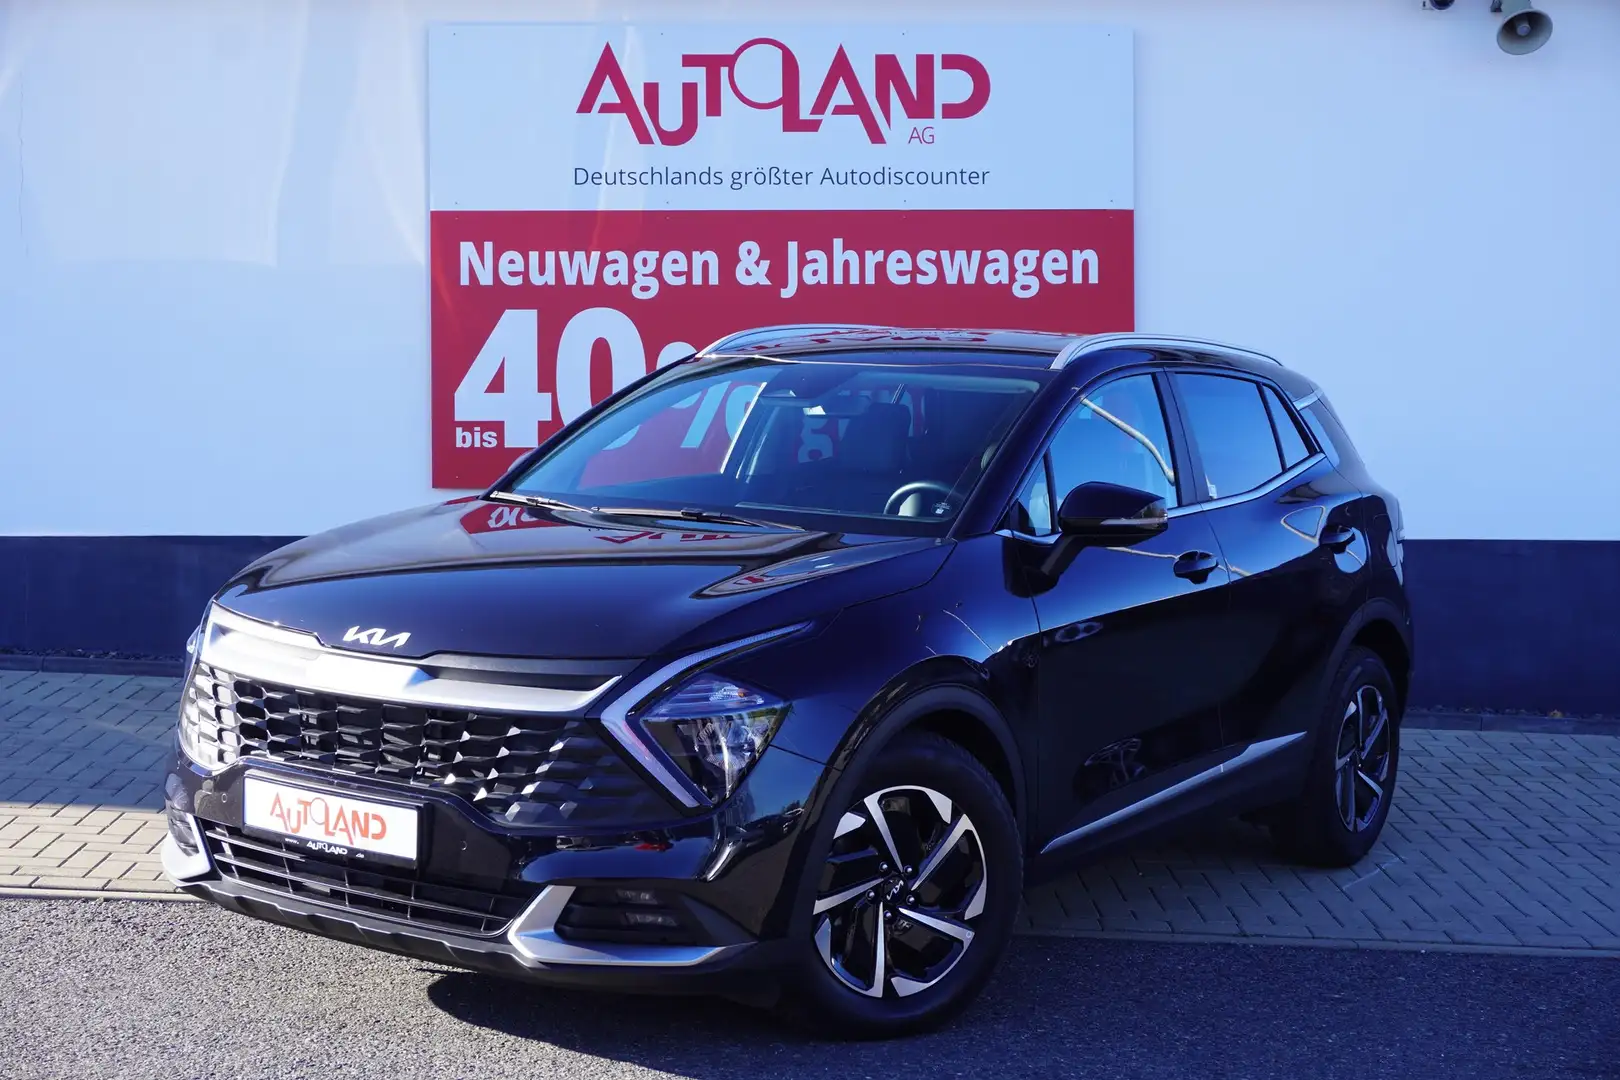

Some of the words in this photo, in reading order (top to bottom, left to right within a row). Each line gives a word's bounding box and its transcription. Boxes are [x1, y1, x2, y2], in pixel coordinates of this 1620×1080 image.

[576, 38, 990, 146] AUTOLAND
[908, 127, 935, 144] AG
[574, 167, 723, 186] Deutschlands
[731, 167, 813, 191] größter
[820, 167, 990, 186] Autodiscounter
[459, 241, 718, 300] Neuwagen
[735, 240, 772, 286] &
[780, 238, 1099, 299] Jahreswagen
[455, 426, 498, 448] bis
[342, 625, 412, 648] KIA
[270, 792, 388, 845] AUTOLAND
[306, 840, 348, 855] AUTOLAND
